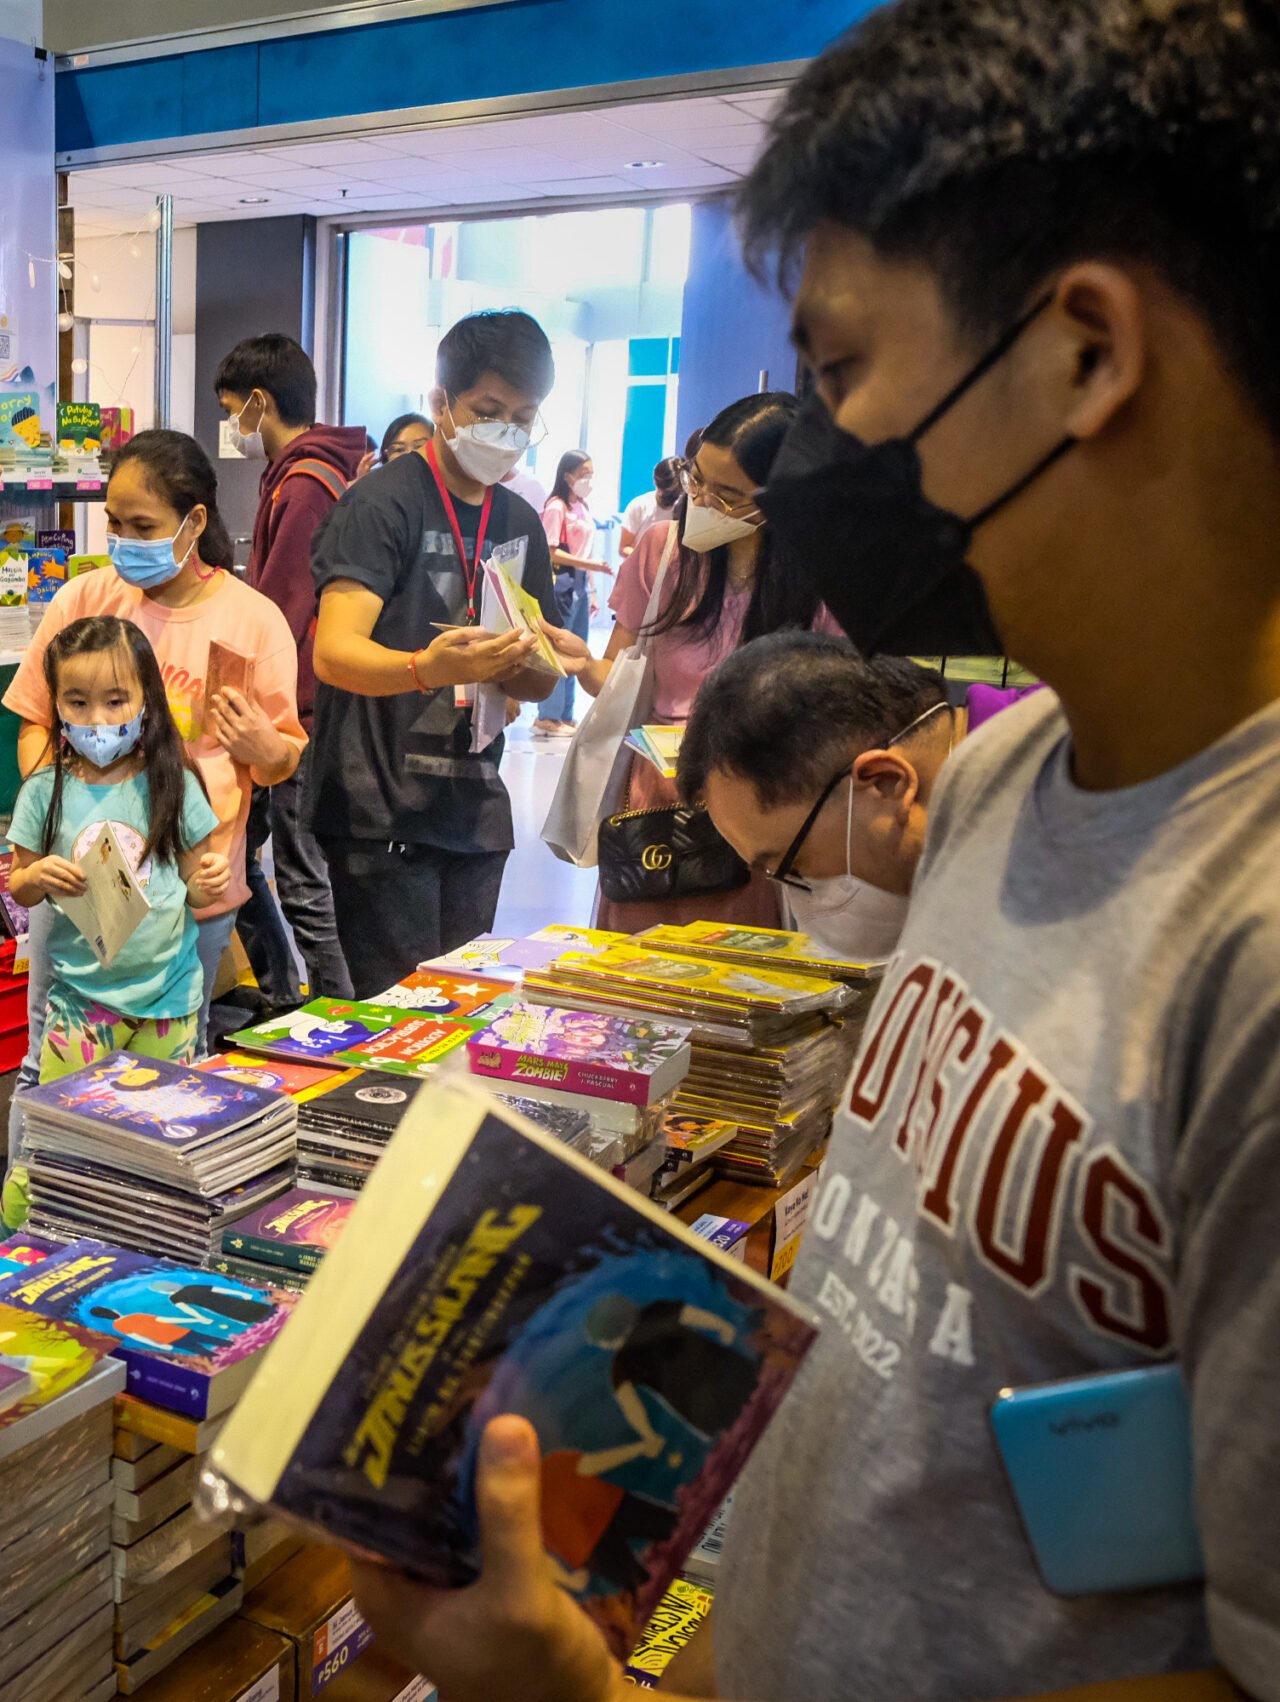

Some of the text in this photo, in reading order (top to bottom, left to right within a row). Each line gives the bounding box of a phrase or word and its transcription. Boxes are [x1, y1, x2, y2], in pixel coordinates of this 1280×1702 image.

[512, 1062, 569, 1083] ZOMBIE!
[577, 1071, 619, 1084] CHUCKBERRY
[587, 1079, 615, 1089] PASCUAL
